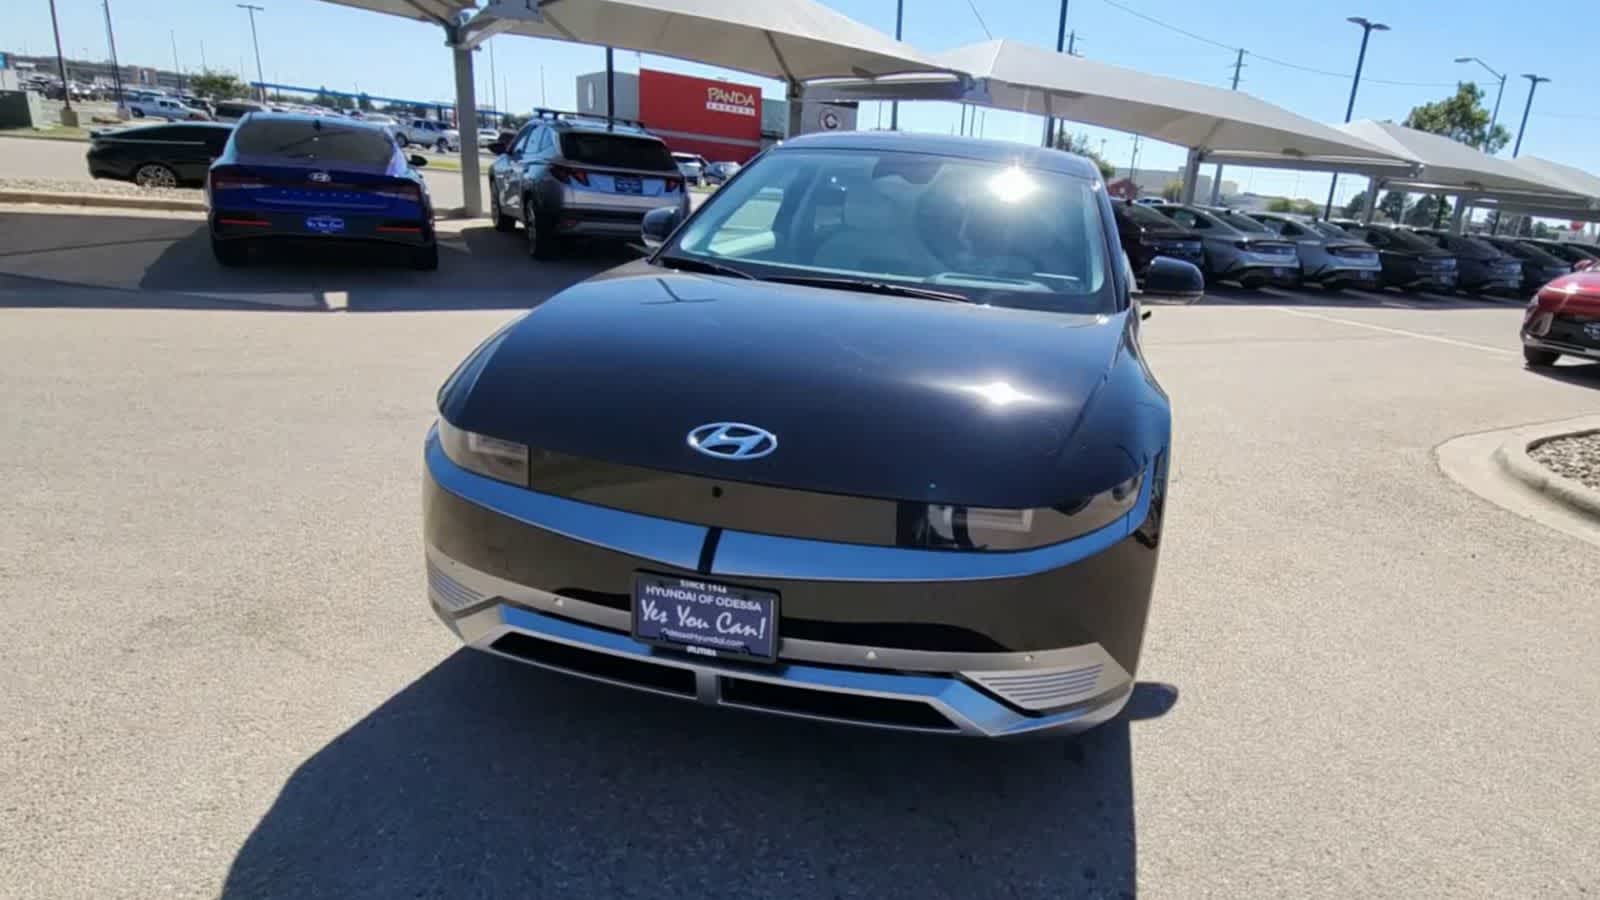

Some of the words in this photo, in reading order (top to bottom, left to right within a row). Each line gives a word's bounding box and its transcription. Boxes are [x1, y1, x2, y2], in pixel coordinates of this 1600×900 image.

[707, 87, 755, 106] PANDA
[680, 579, 705, 590] SINCE
[646, 586, 697, 602] HYUNDAI
[698, 594, 714, 605] OF
[715, 598, 762, 612] ODESSA
[641, 599, 668, 623] Yes
[678, 605, 710, 628] You
[716, 612, 767, 639] Can!
